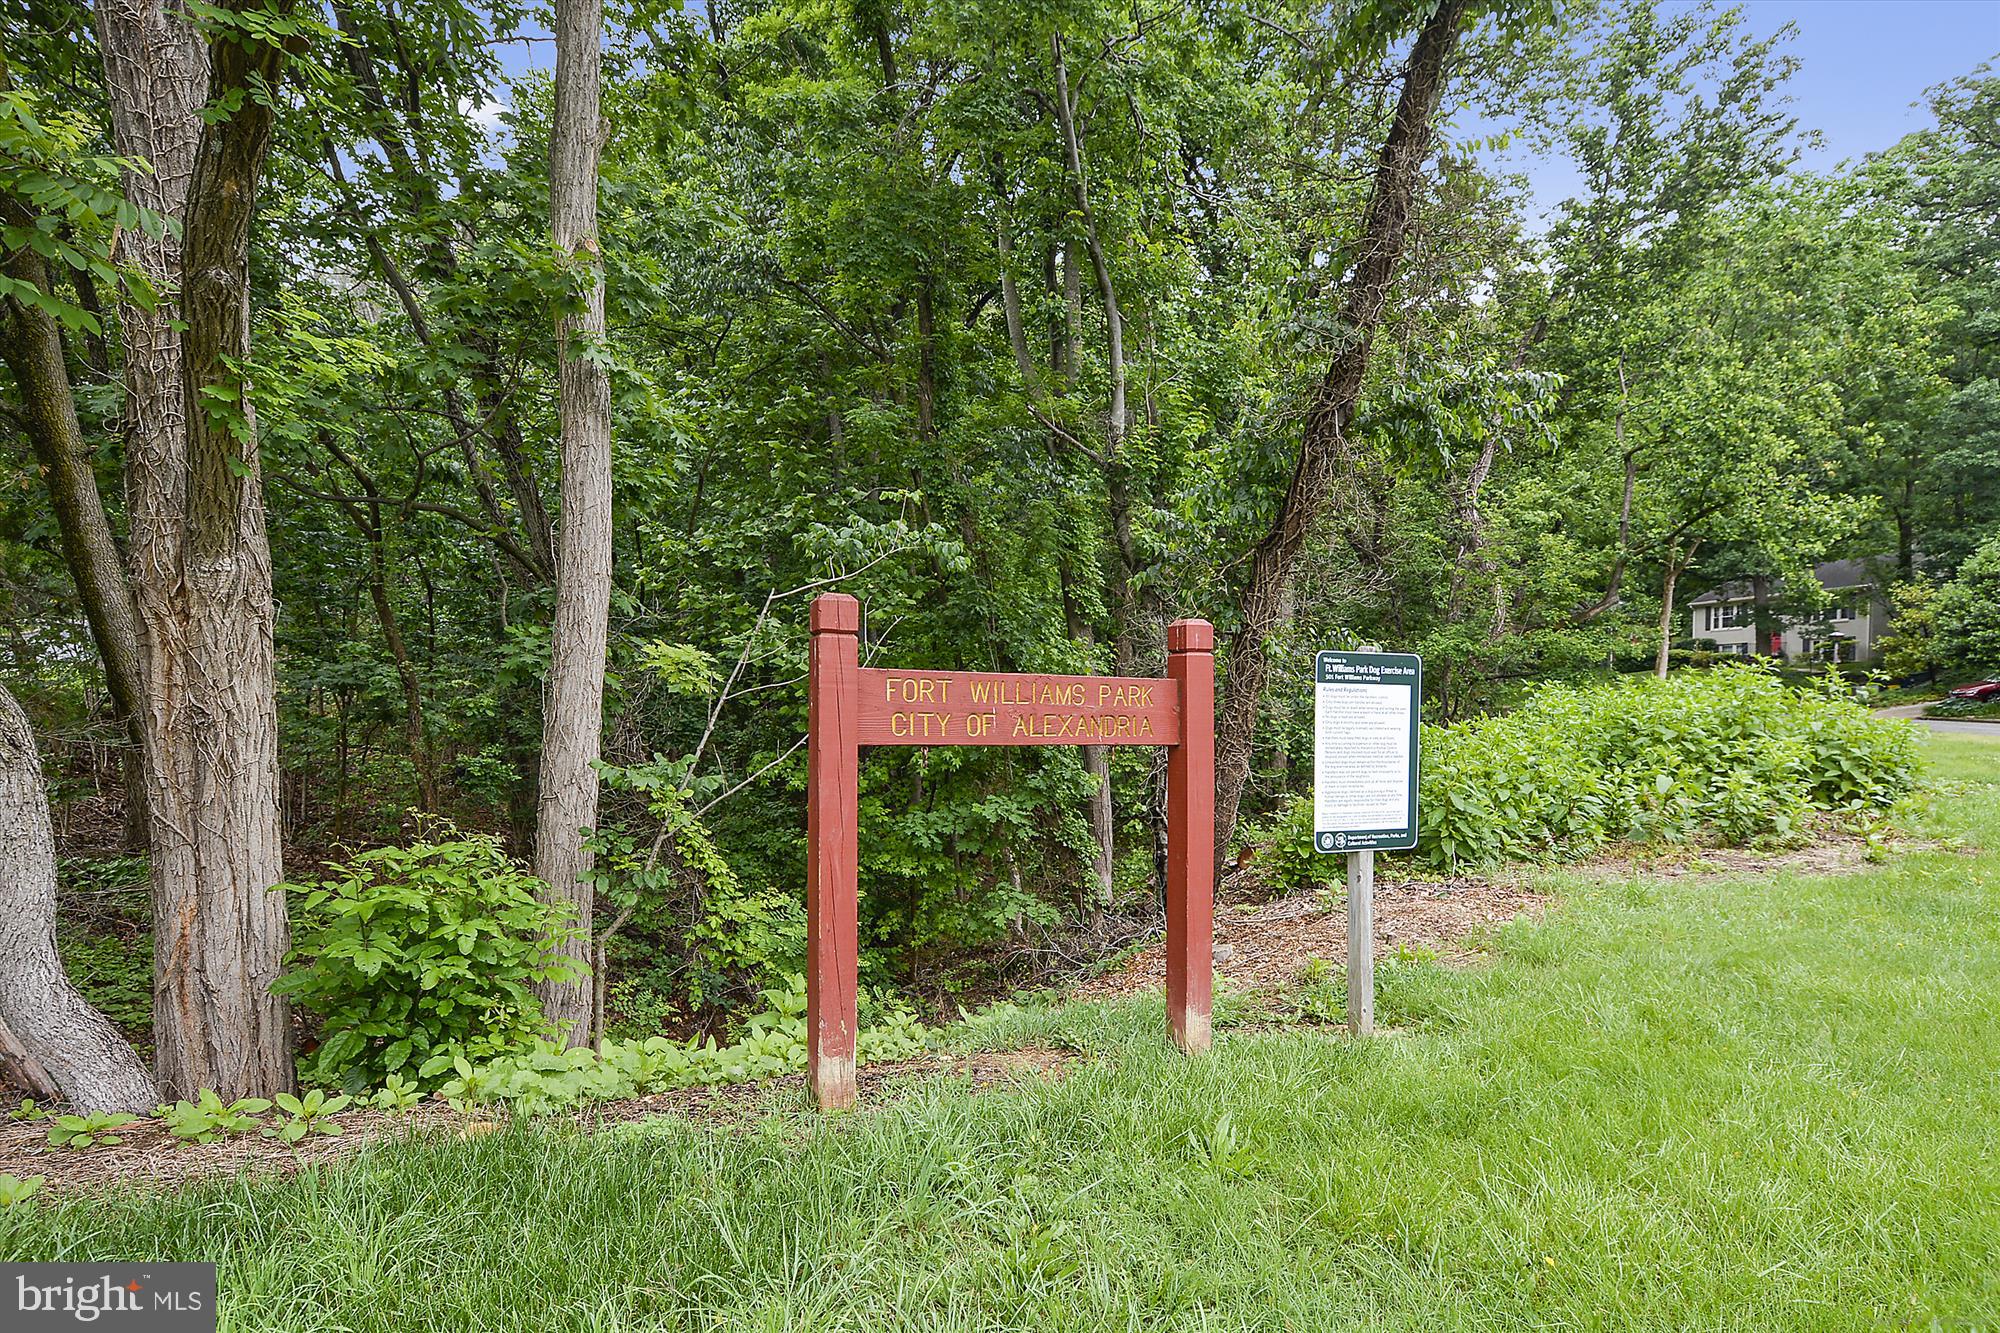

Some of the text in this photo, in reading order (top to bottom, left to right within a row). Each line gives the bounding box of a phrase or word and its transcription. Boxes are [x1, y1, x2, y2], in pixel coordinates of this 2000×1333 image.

[1332, 665, 1355, 673] Williams
[1356, 665, 1368, 673] Park
[1369, 666, 1380, 675] Dog
[1381, 666, 1402, 674] Exercise
[1403, 667, 1415, 675] Area
[886, 678, 1154, 707] FORT WILLIAMS PARK
[891, 712, 1154, 738] CITY OF ALEXANDRIA
